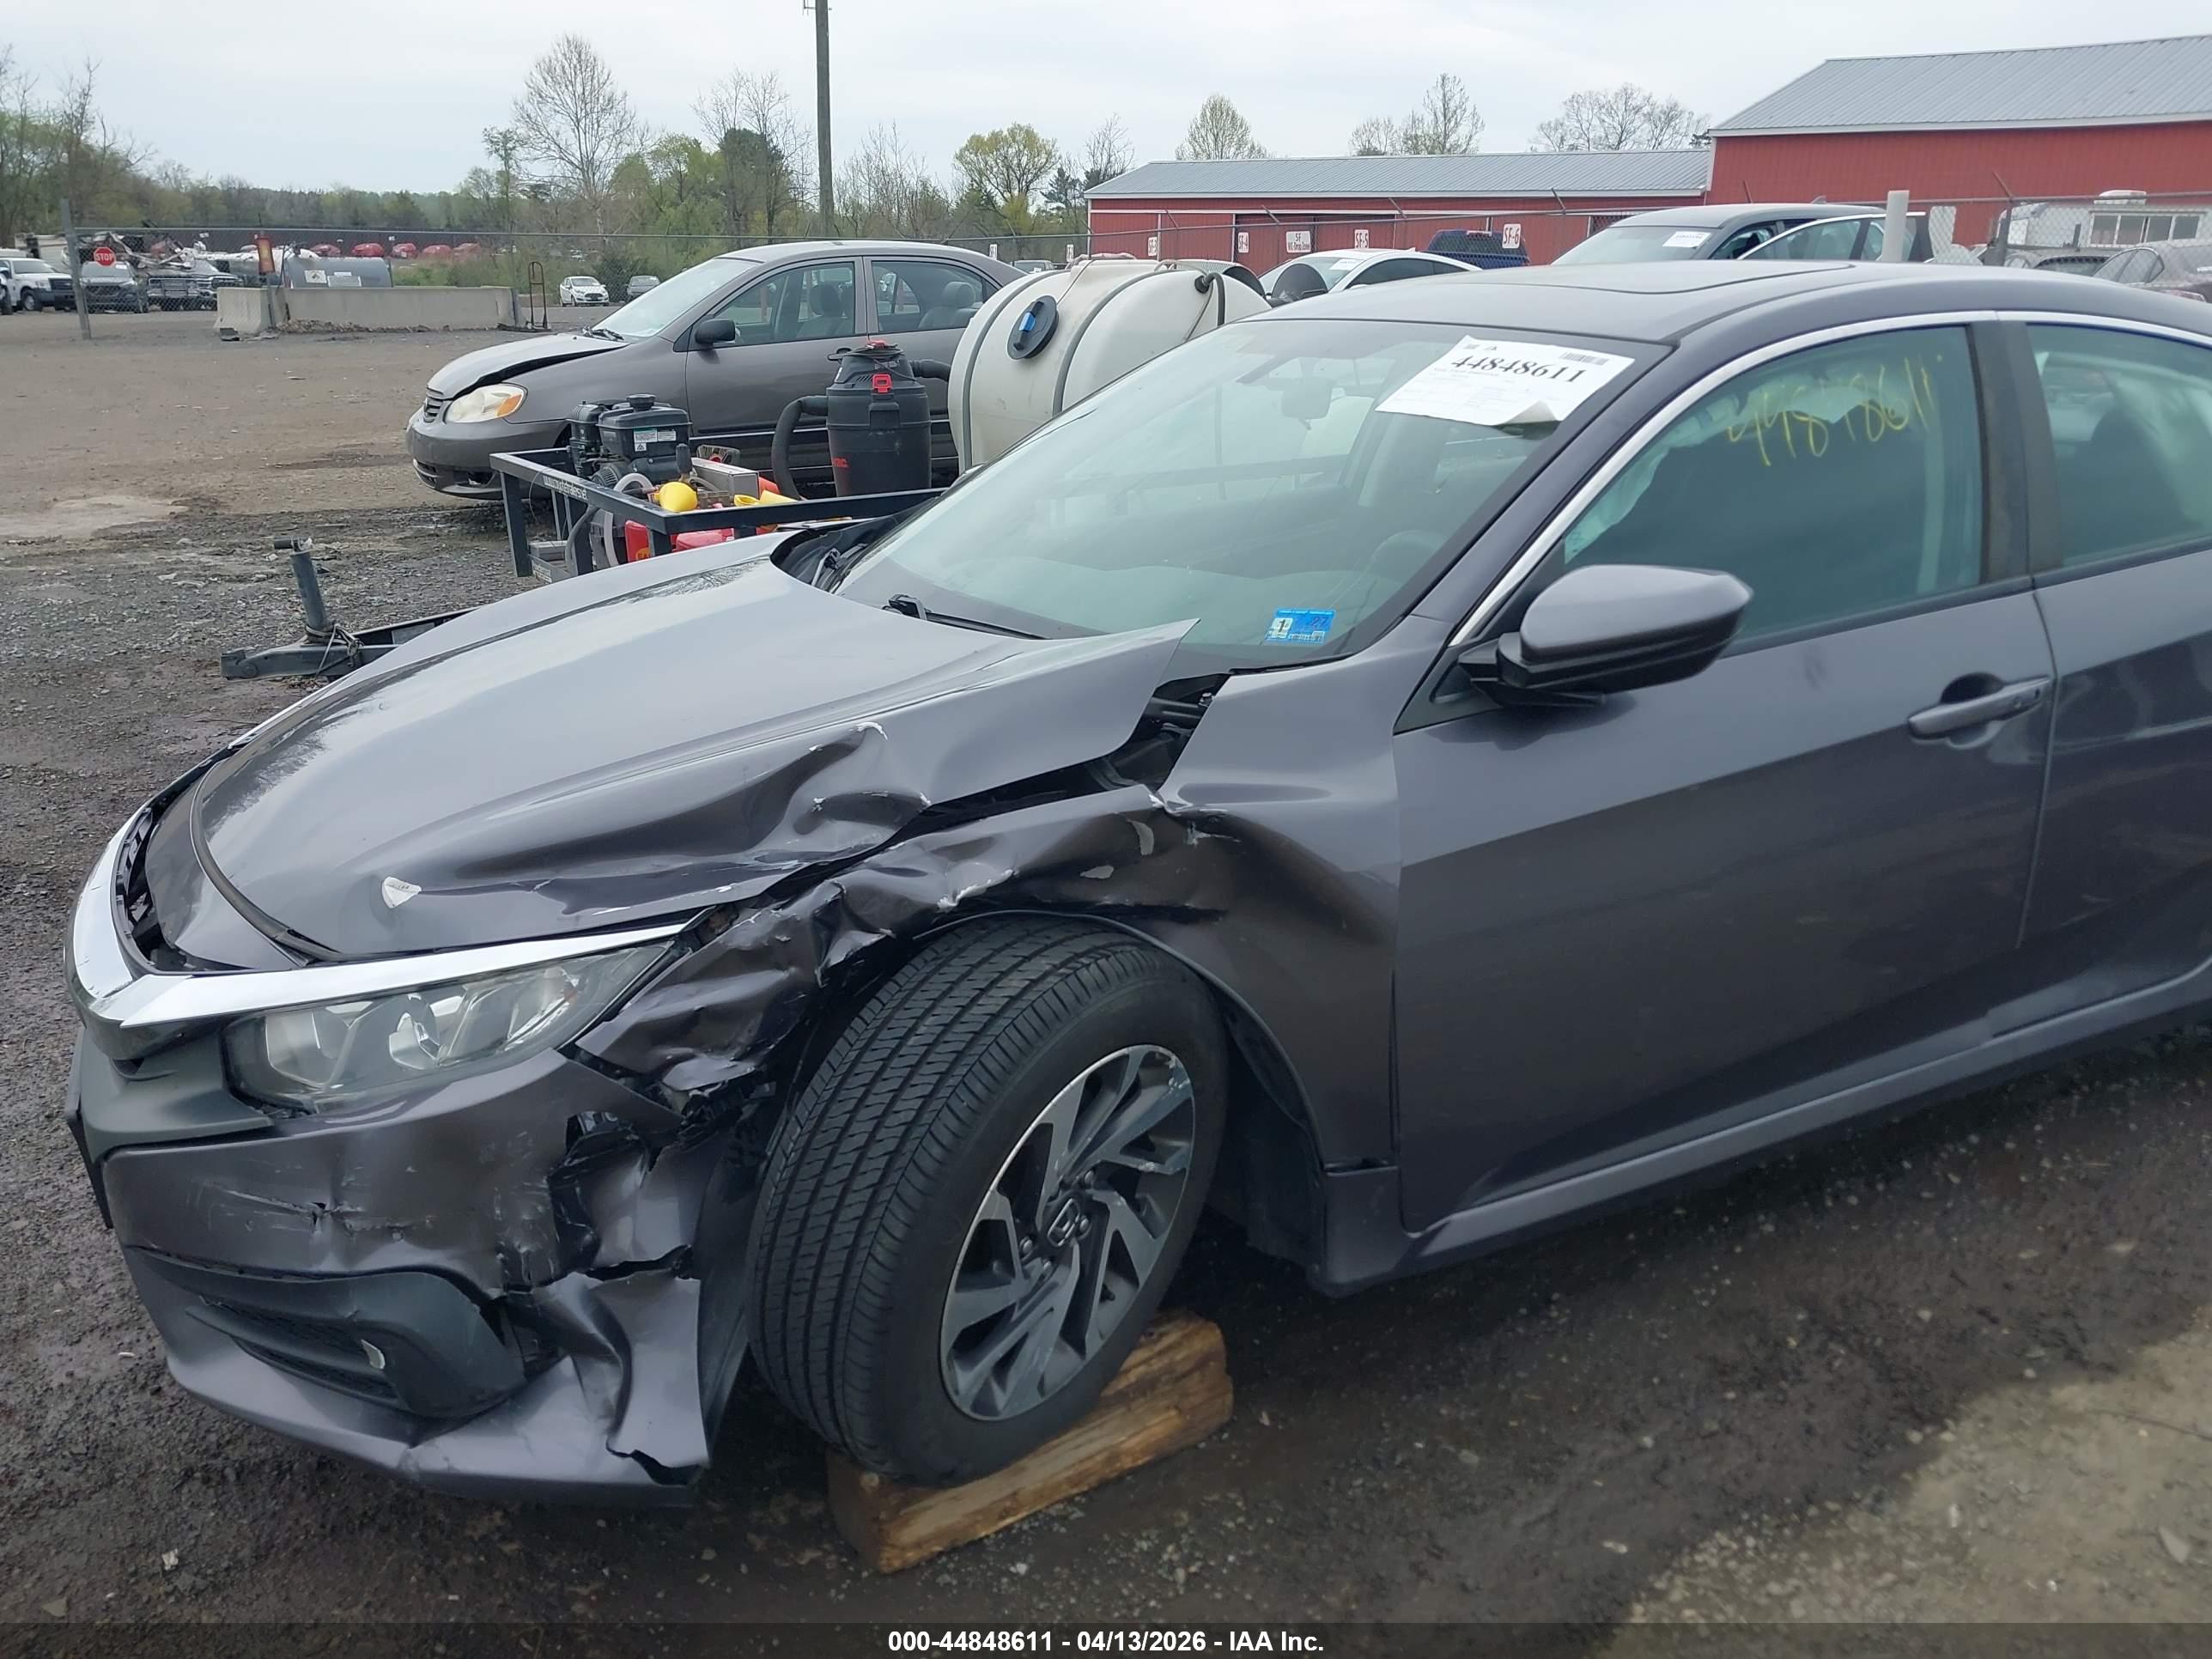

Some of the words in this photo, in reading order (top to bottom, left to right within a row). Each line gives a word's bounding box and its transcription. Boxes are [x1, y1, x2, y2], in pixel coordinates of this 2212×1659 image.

[1238, 235, 1249, 250] SF-4
[1355, 232, 1368, 248] SF-5
[1504, 227, 1519, 245] SF-6
[95, 252, 114, 261] STOP
[1451, 356, 1587, 383] 44848611
[1278, 618, 1286, 633] 1
